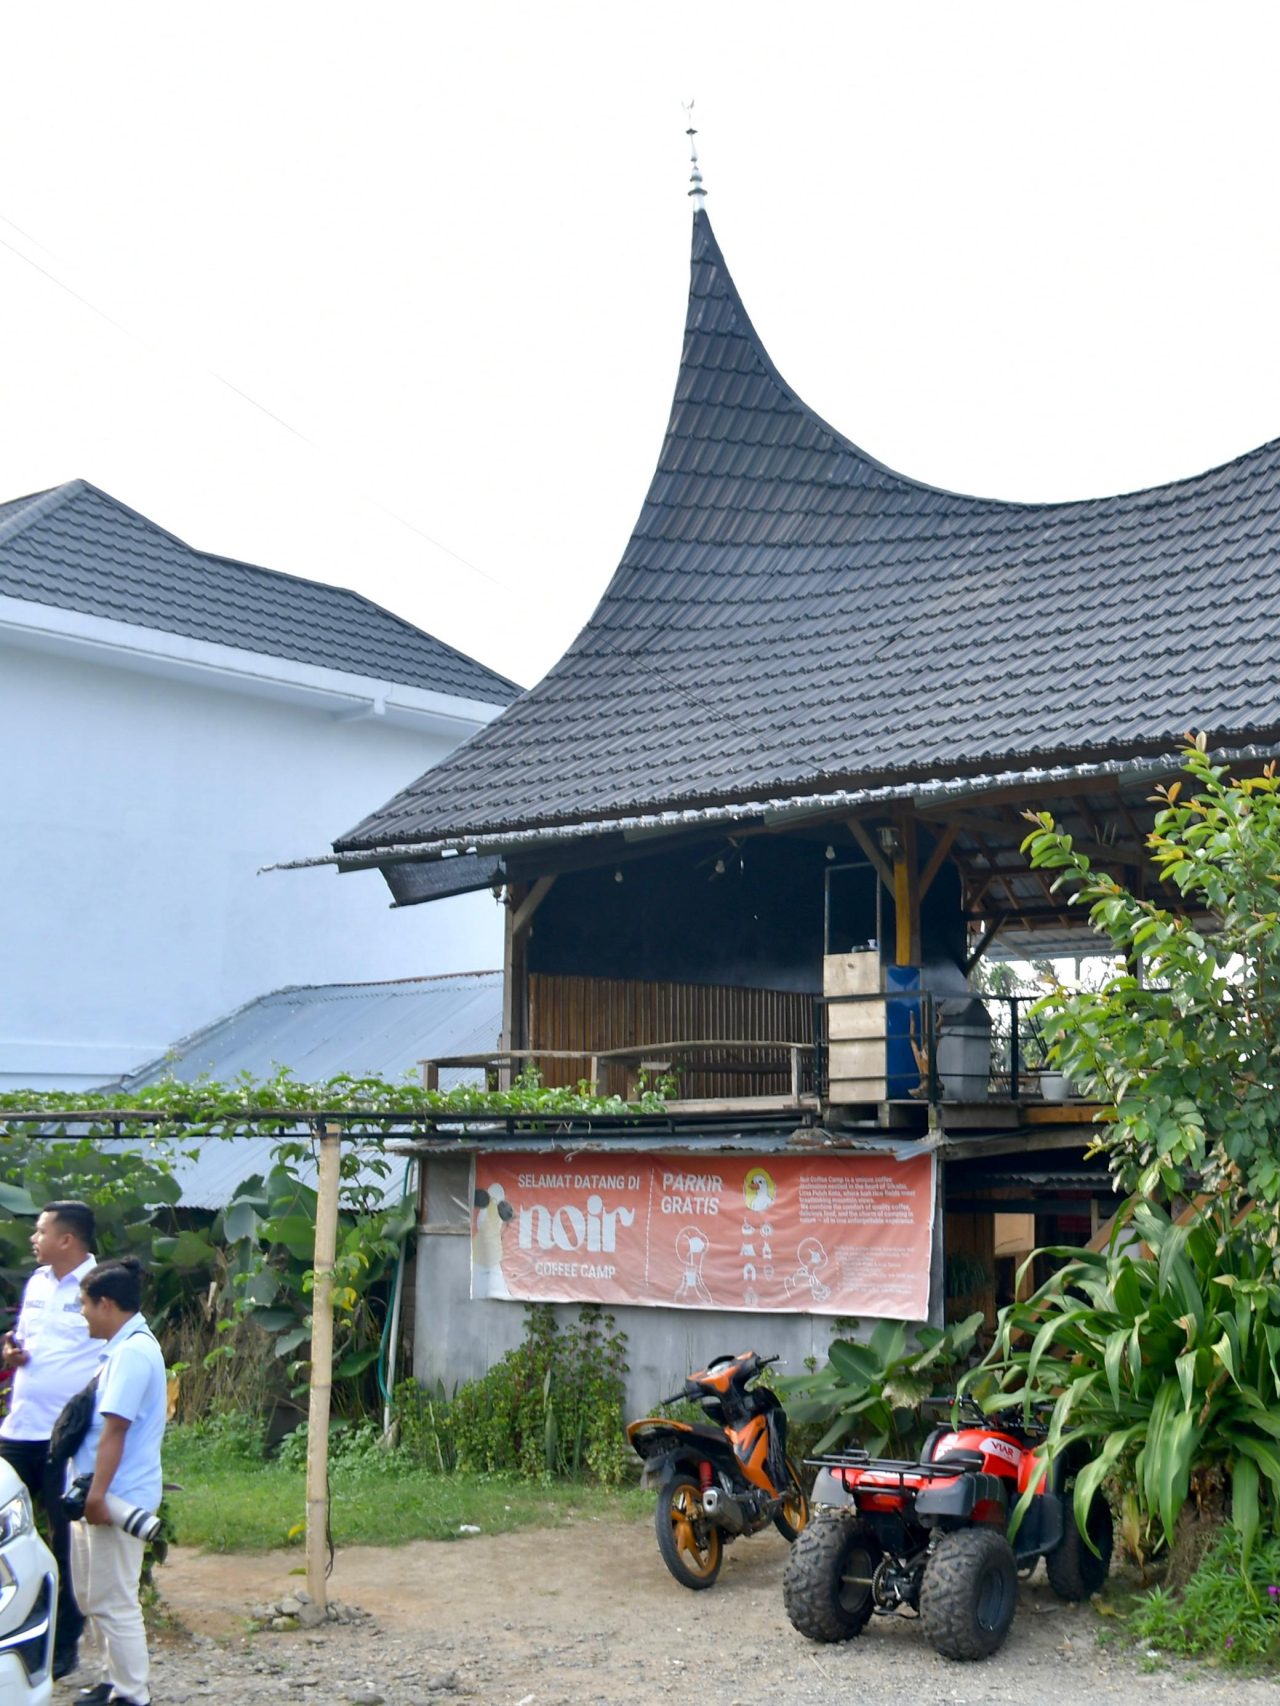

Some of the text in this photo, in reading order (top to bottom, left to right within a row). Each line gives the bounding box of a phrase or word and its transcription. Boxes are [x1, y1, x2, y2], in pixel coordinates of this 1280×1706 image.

[518, 1173, 640, 1190] SELAMAT DATANG DI
[662, 1173, 723, 1192] PARKIR
[661, 1195, 720, 1215] GRATIS
[518, 1193, 635, 1253] noir
[535, 1261, 616, 1279] COFFEE CAMP
[992, 1441, 1014, 1457] VIAR
